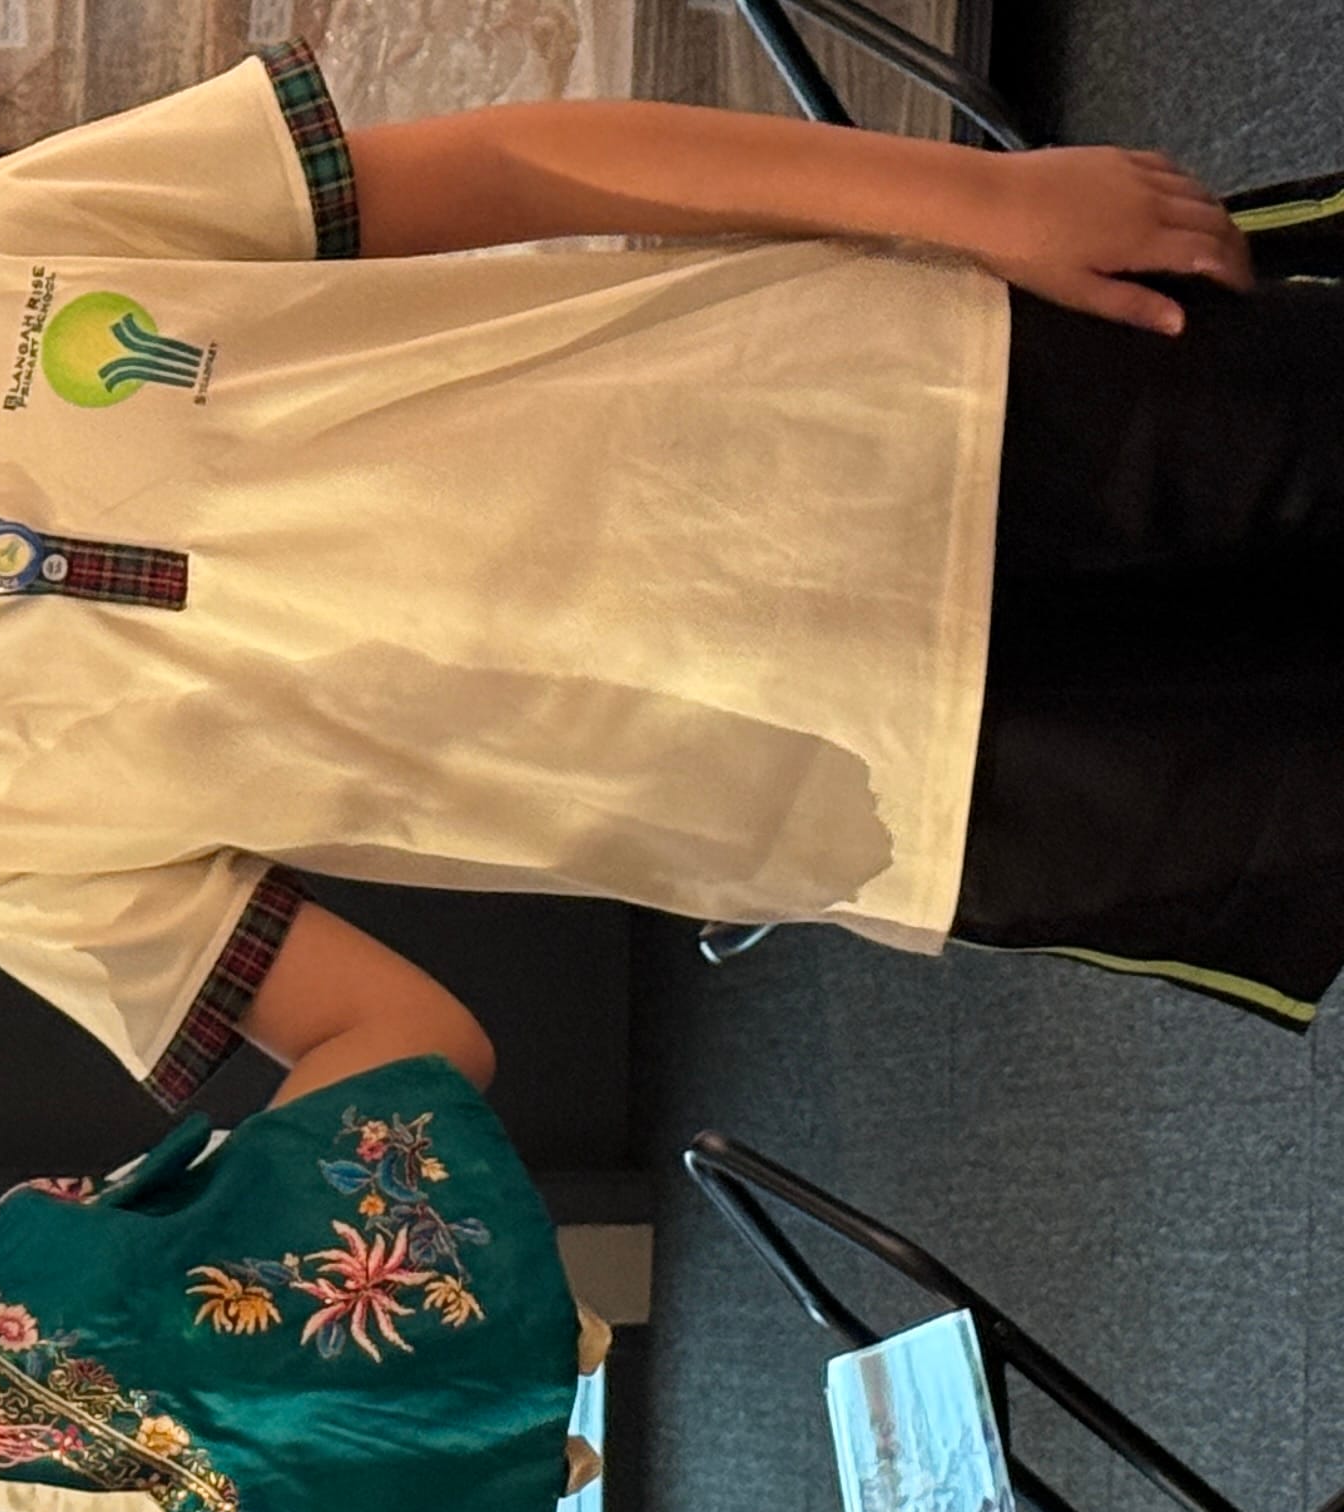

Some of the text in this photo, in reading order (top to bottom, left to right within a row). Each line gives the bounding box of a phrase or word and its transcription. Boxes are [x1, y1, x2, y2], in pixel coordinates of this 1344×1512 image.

[2, 264, 45, 411] BLANGAH RISE
[17, 271, 57, 409] PRIMARY SCHOOL
